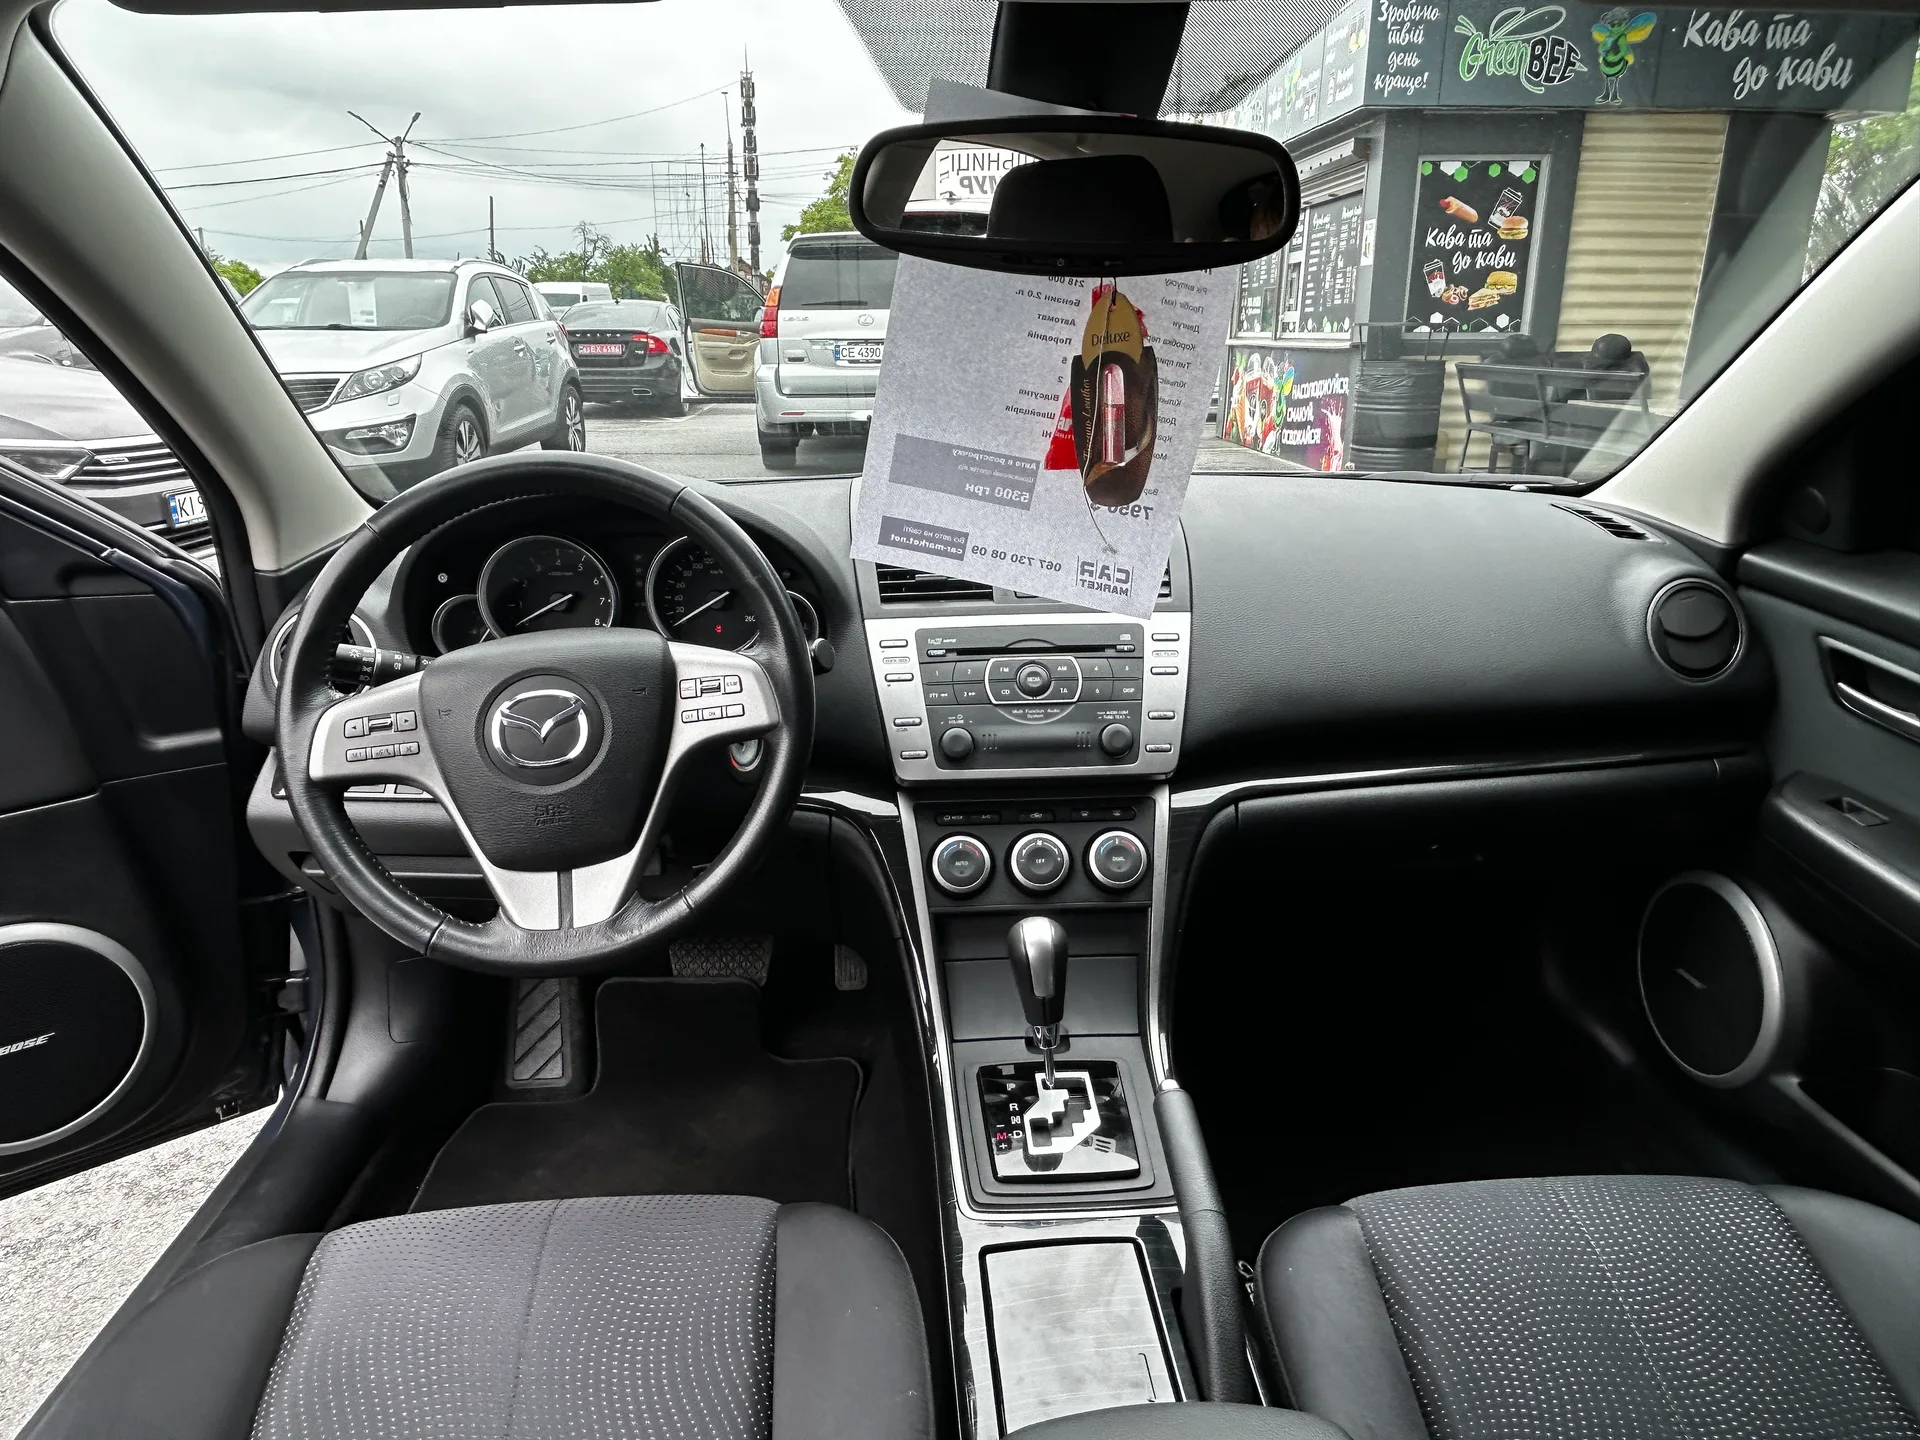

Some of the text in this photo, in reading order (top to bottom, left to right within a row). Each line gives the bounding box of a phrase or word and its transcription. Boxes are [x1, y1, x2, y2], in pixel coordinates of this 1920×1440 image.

[1377, 0, 1440, 22] Зробимо
[1388, 24, 1425, 46] твій
[1683, 9, 1814, 52] Кава та
[1388, 51, 1421, 73] день
[1732, 42, 1854, 100] до кави
[1373, 72, 1430, 98] краще!
[1425, 224, 1495, 250] Кава та
[1452, 244, 1517, 274] до кави
[1091, 329, 1131, 347] Deluxe
[840, 347, 882, 358] CE 4390
[577, 563, 583, 571] 5
[599, 597, 605, 605] 7
[594, 618, 601, 626] 8
[0, 1032, 55, 1056] BOSE
[1006, 1083, 1016, 1091] P
[1009, 1103, 1019, 1111] R
[1011, 1115, 1021, 1125] N
